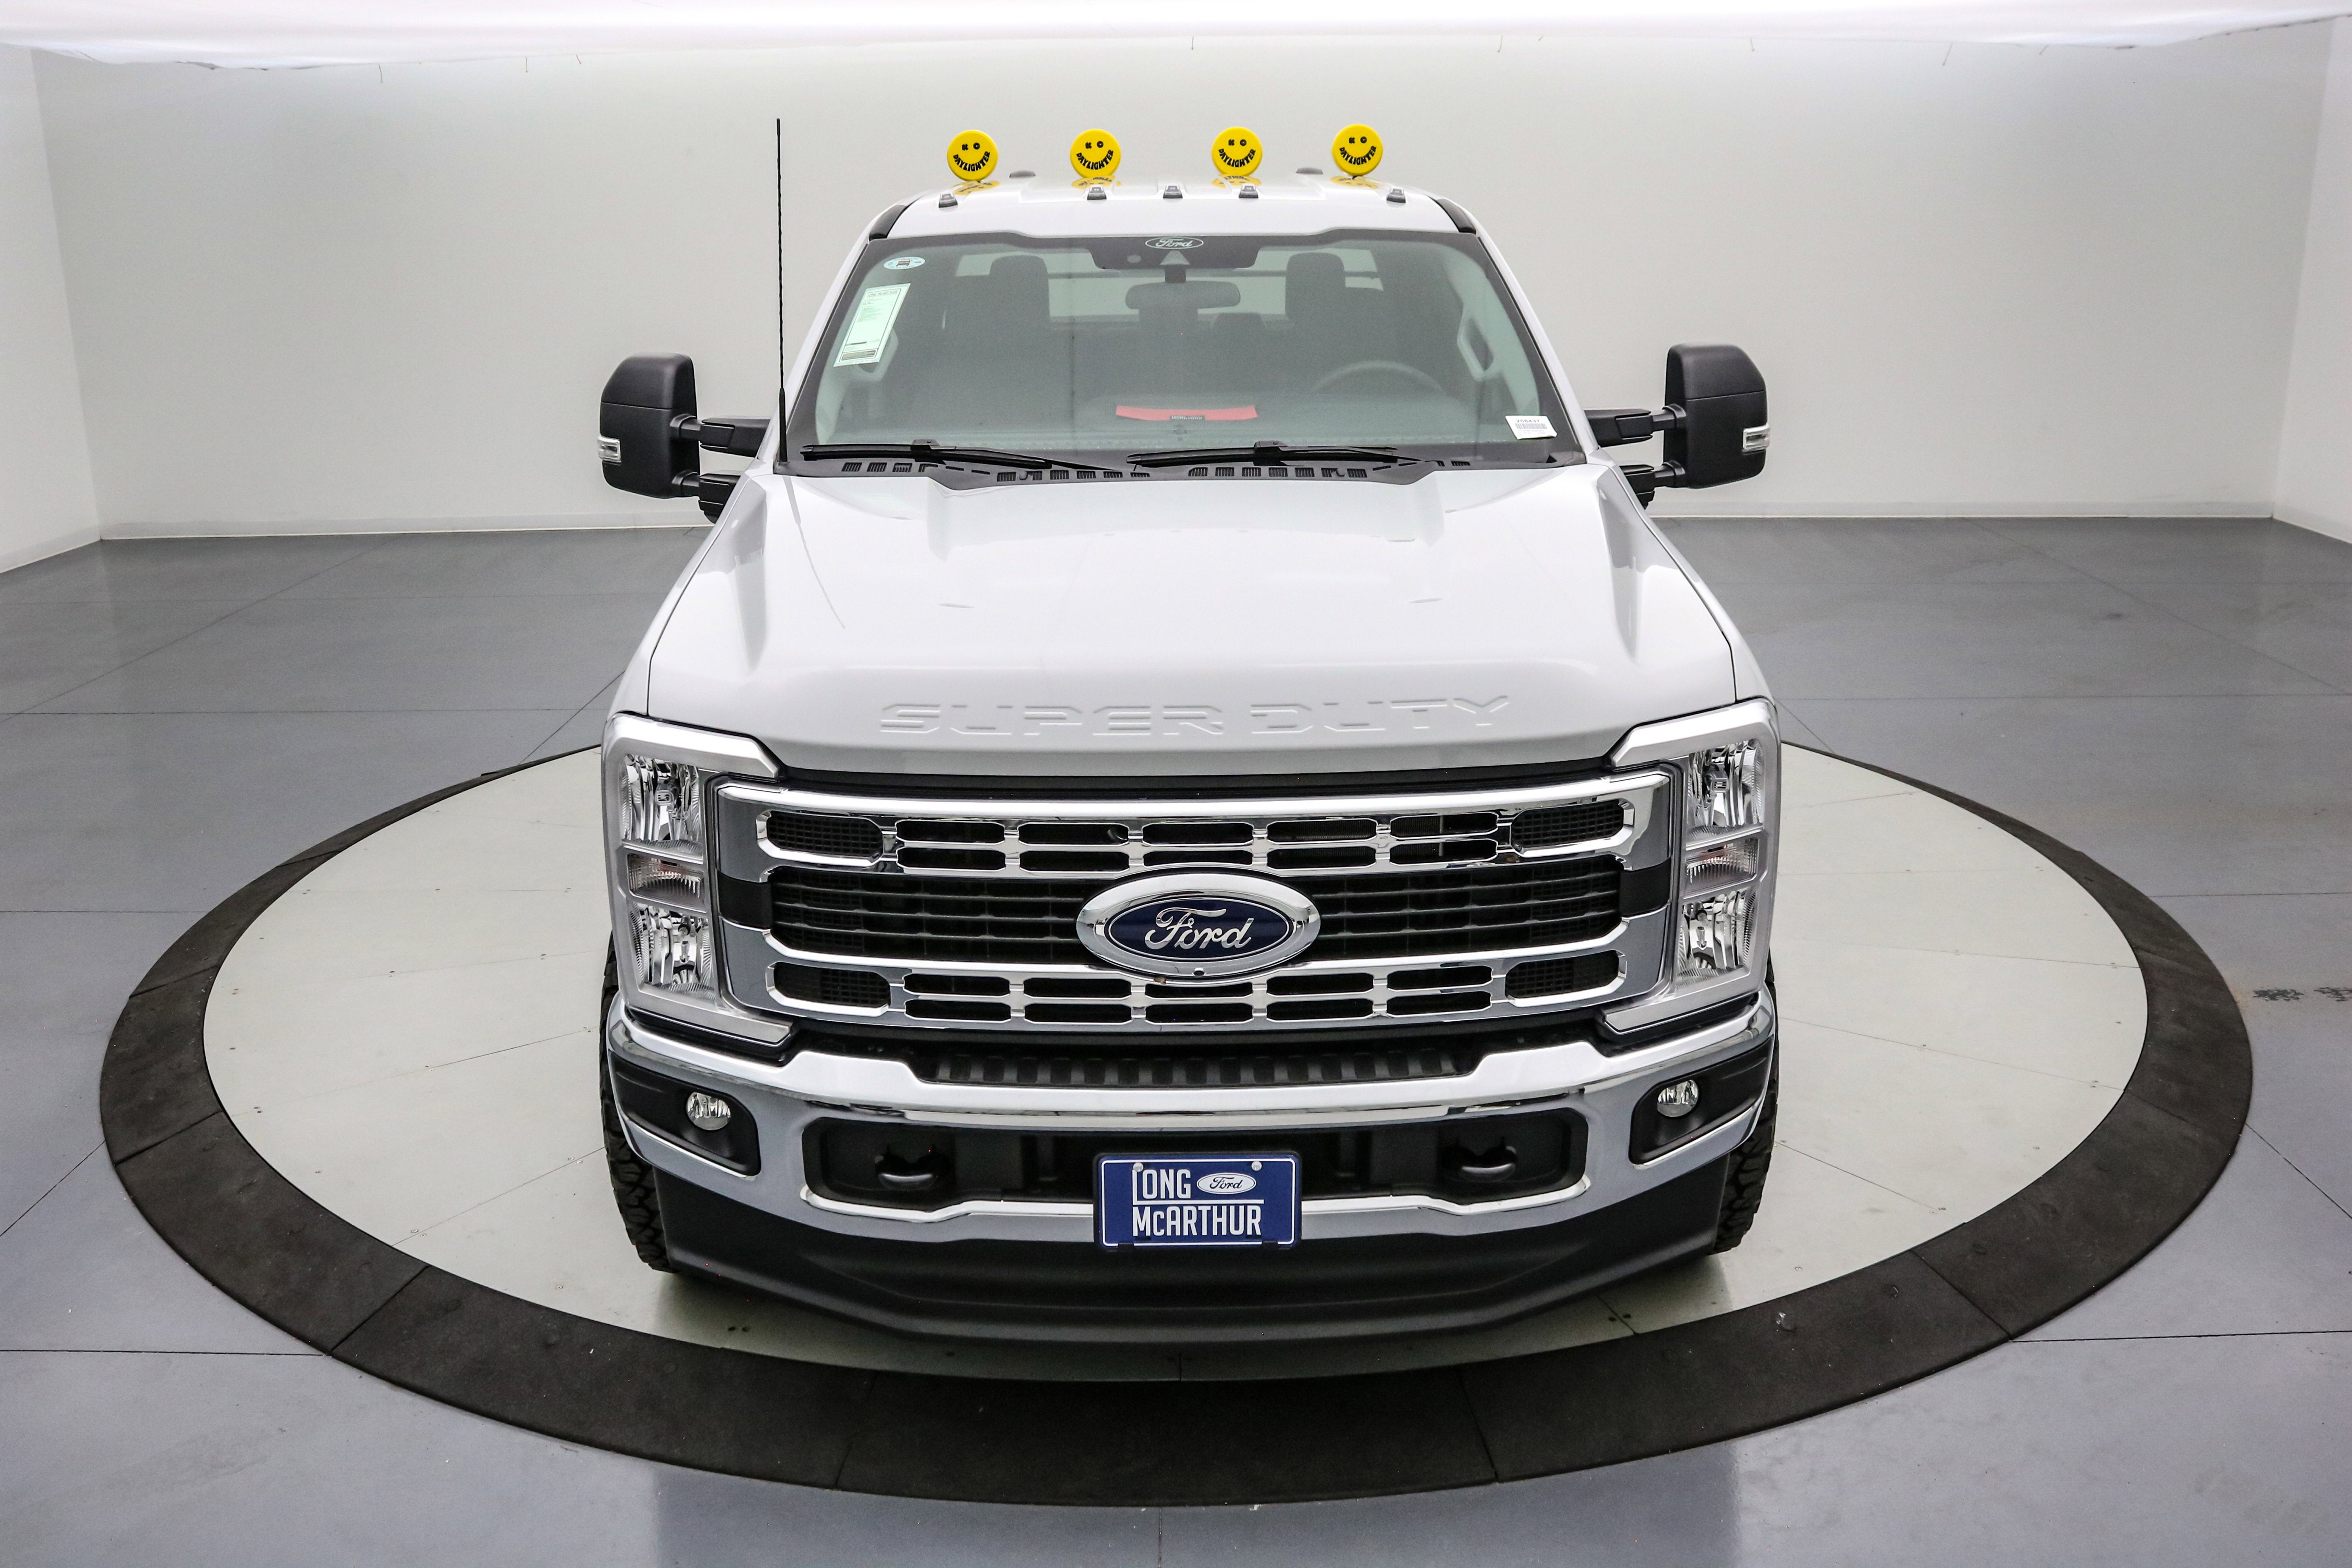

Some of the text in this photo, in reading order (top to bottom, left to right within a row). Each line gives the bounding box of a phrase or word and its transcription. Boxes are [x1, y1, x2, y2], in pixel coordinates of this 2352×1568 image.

[953, 151, 990, 171] DAYLIGHTER
[1077, 150, 1113, 169] DAYLIGHTER
[1219, 149, 1256, 167] DAYLIGHTER
[1340, 146, 1376, 165] DAYLIGHTER
[1155, 238, 1193, 247] Ford
[880, 695, 1510, 735] SUPER DUTY
[1144, 907, 1254, 950] Ford
[1132, 1168, 1243, 1205] LONG Ford
[1133, 1205, 1261, 1236] McARTHUR
